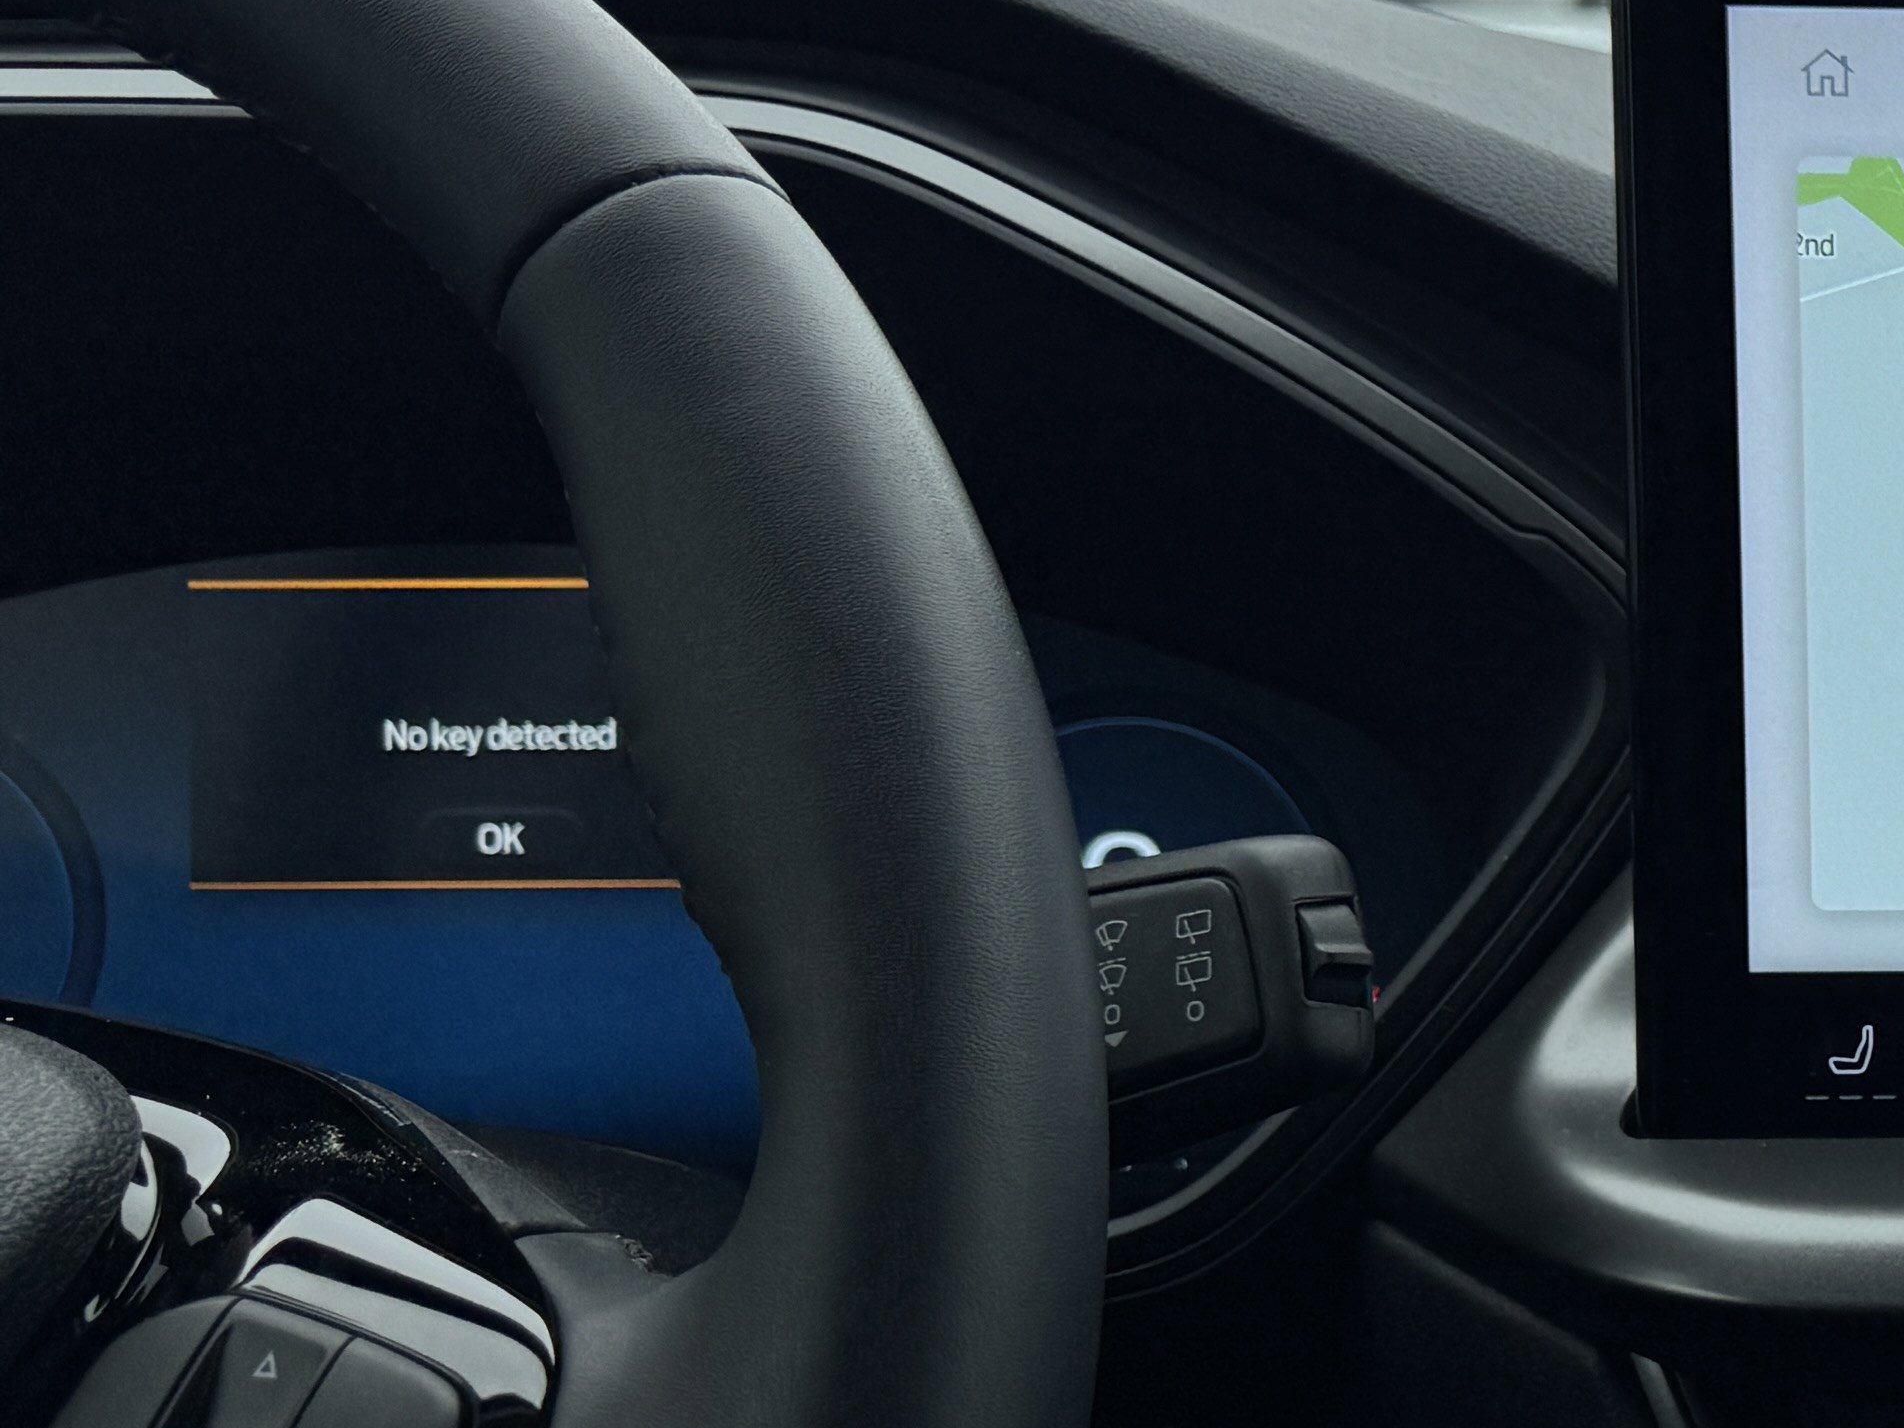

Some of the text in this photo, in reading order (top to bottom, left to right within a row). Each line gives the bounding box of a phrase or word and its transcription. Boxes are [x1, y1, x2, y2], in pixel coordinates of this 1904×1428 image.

[383, 716, 617, 757] No key detected
[477, 822, 525, 855] OK
